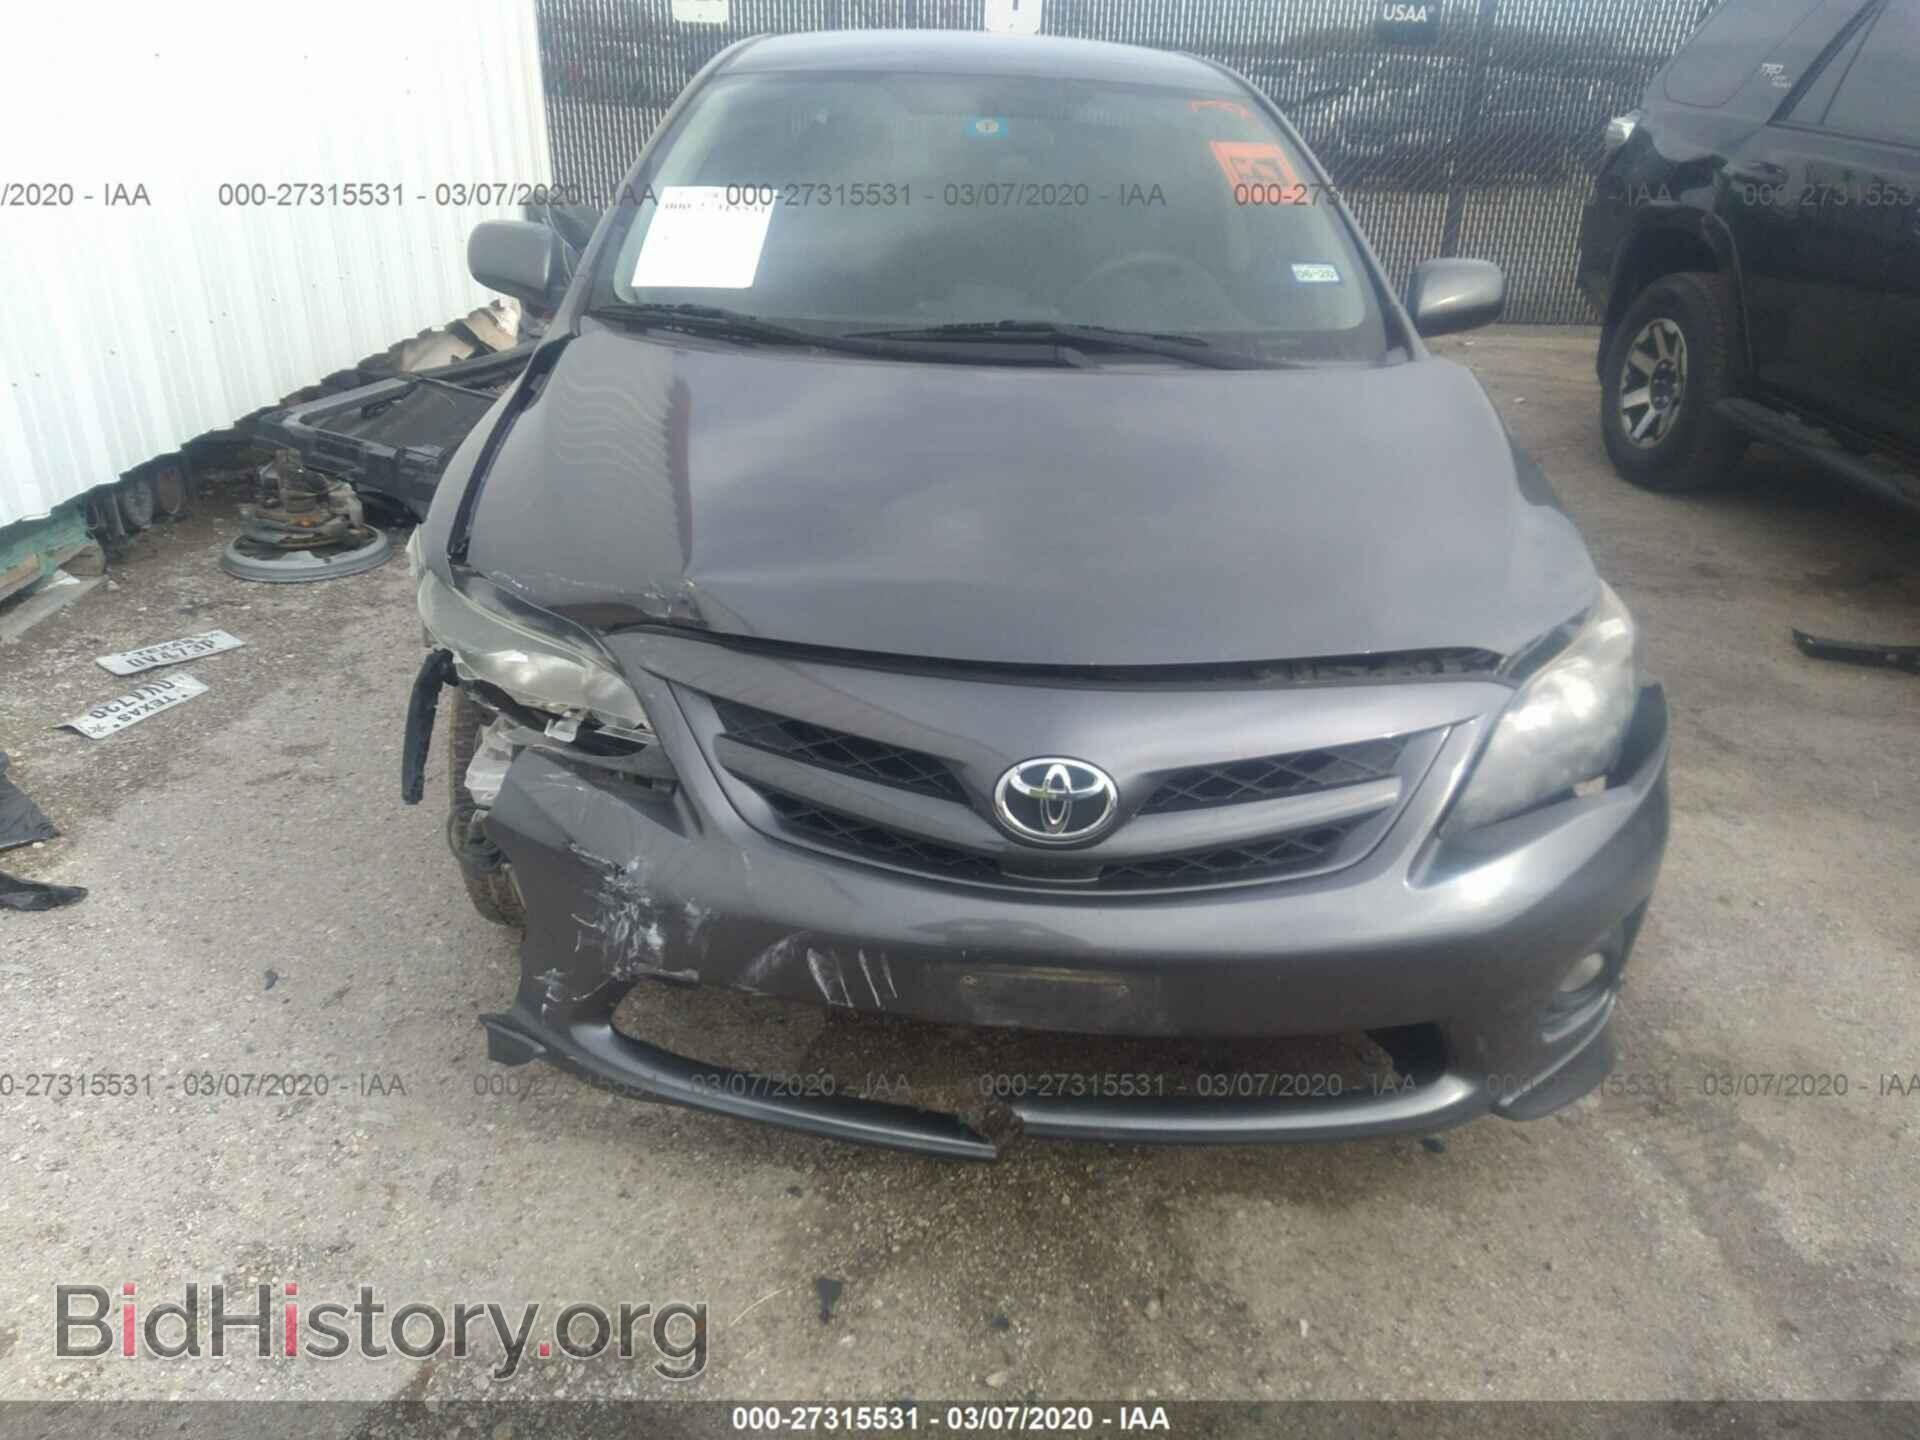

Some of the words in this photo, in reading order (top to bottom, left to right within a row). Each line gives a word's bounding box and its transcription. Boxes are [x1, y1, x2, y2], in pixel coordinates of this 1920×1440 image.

[1383, 4, 1427, 22] USAA
[135, 639, 195, 656] TEXAS
[117, 695, 176, 722] TEXAS
